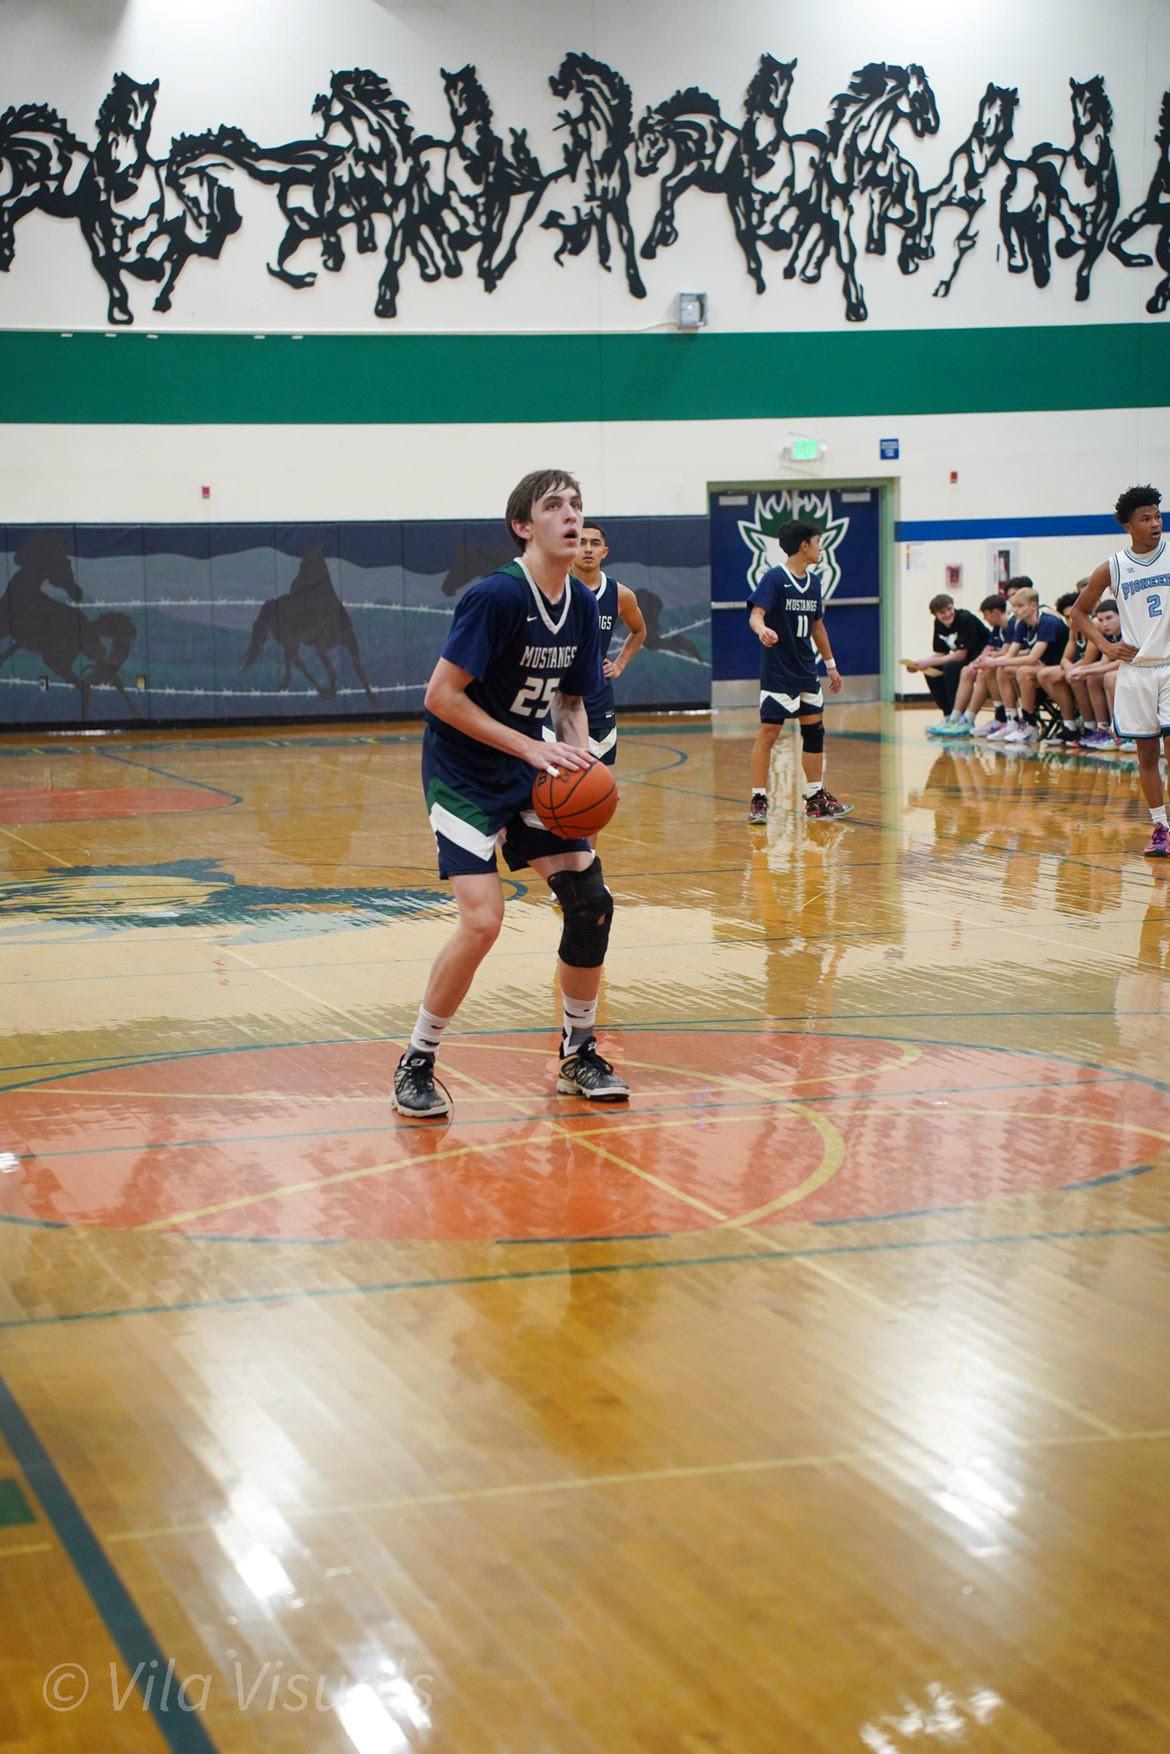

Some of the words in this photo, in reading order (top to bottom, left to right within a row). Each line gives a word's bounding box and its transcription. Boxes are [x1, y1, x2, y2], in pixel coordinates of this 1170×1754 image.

[785, 598, 818, 612] MUSTANGS
[1146, 594, 1163, 618] 2
[796, 614, 809, 638] 11
[510, 676, 561, 719] 25
